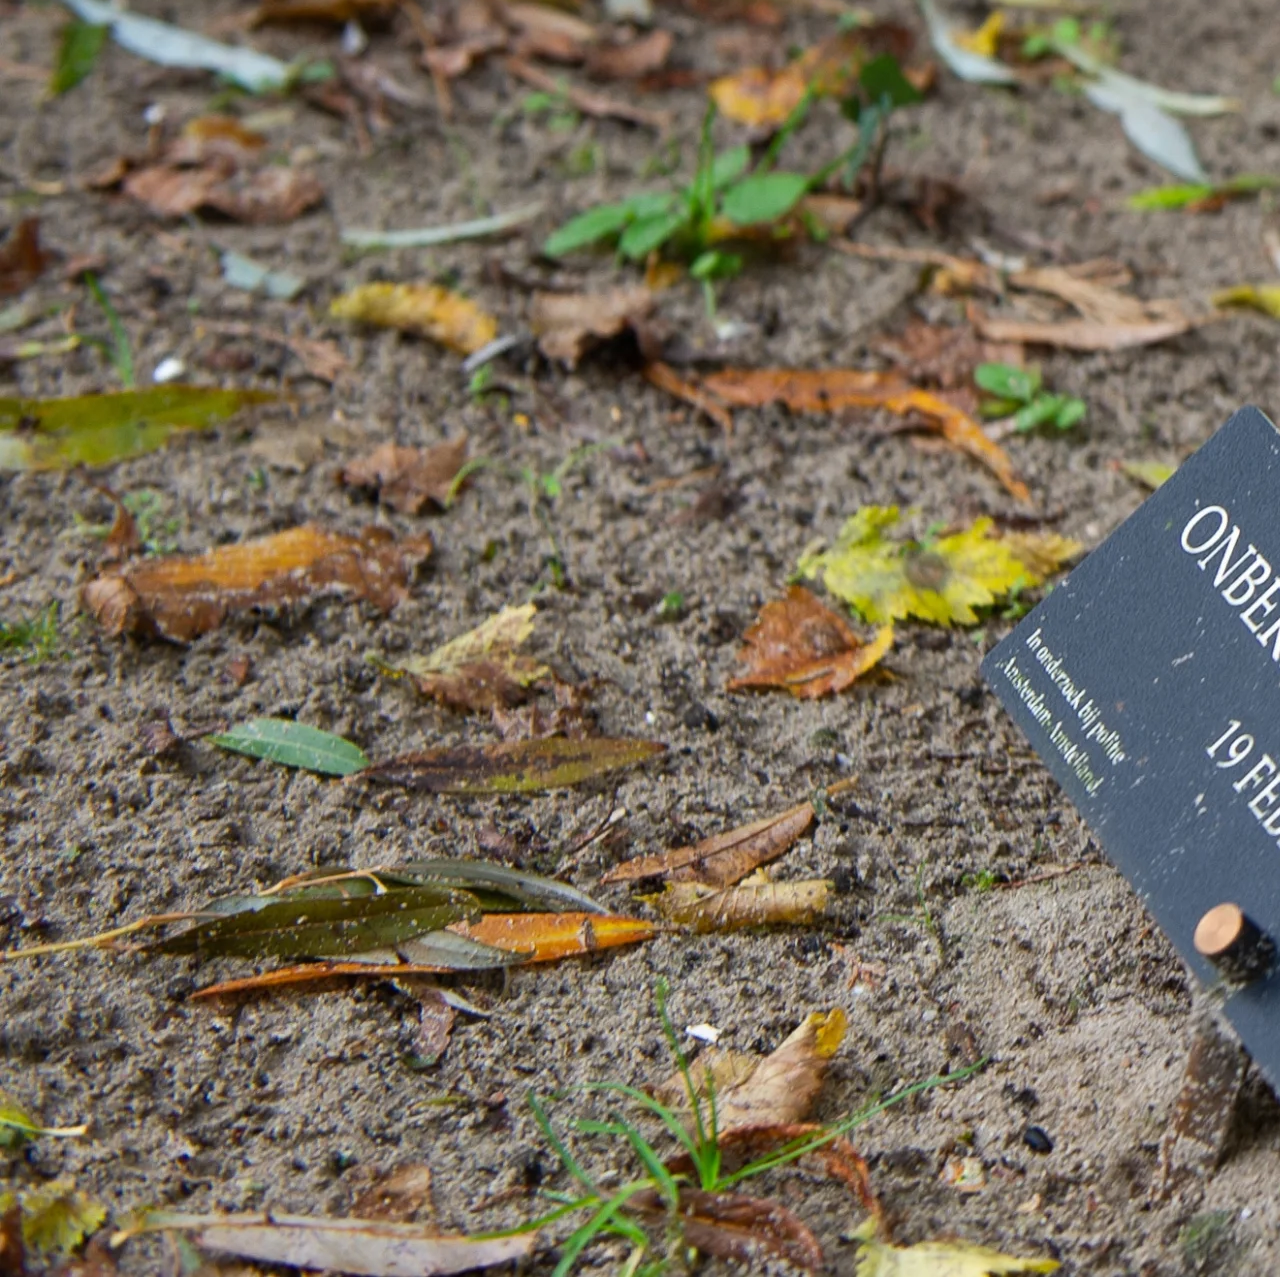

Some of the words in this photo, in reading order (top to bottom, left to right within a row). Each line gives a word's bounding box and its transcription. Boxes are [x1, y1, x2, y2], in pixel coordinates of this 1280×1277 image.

[1026, 627, 1042, 652] In
[1036, 646, 1086, 710] onderzoek
[1077, 699, 1102, 731] bij
[1205, 719, 1254, 769] 19
